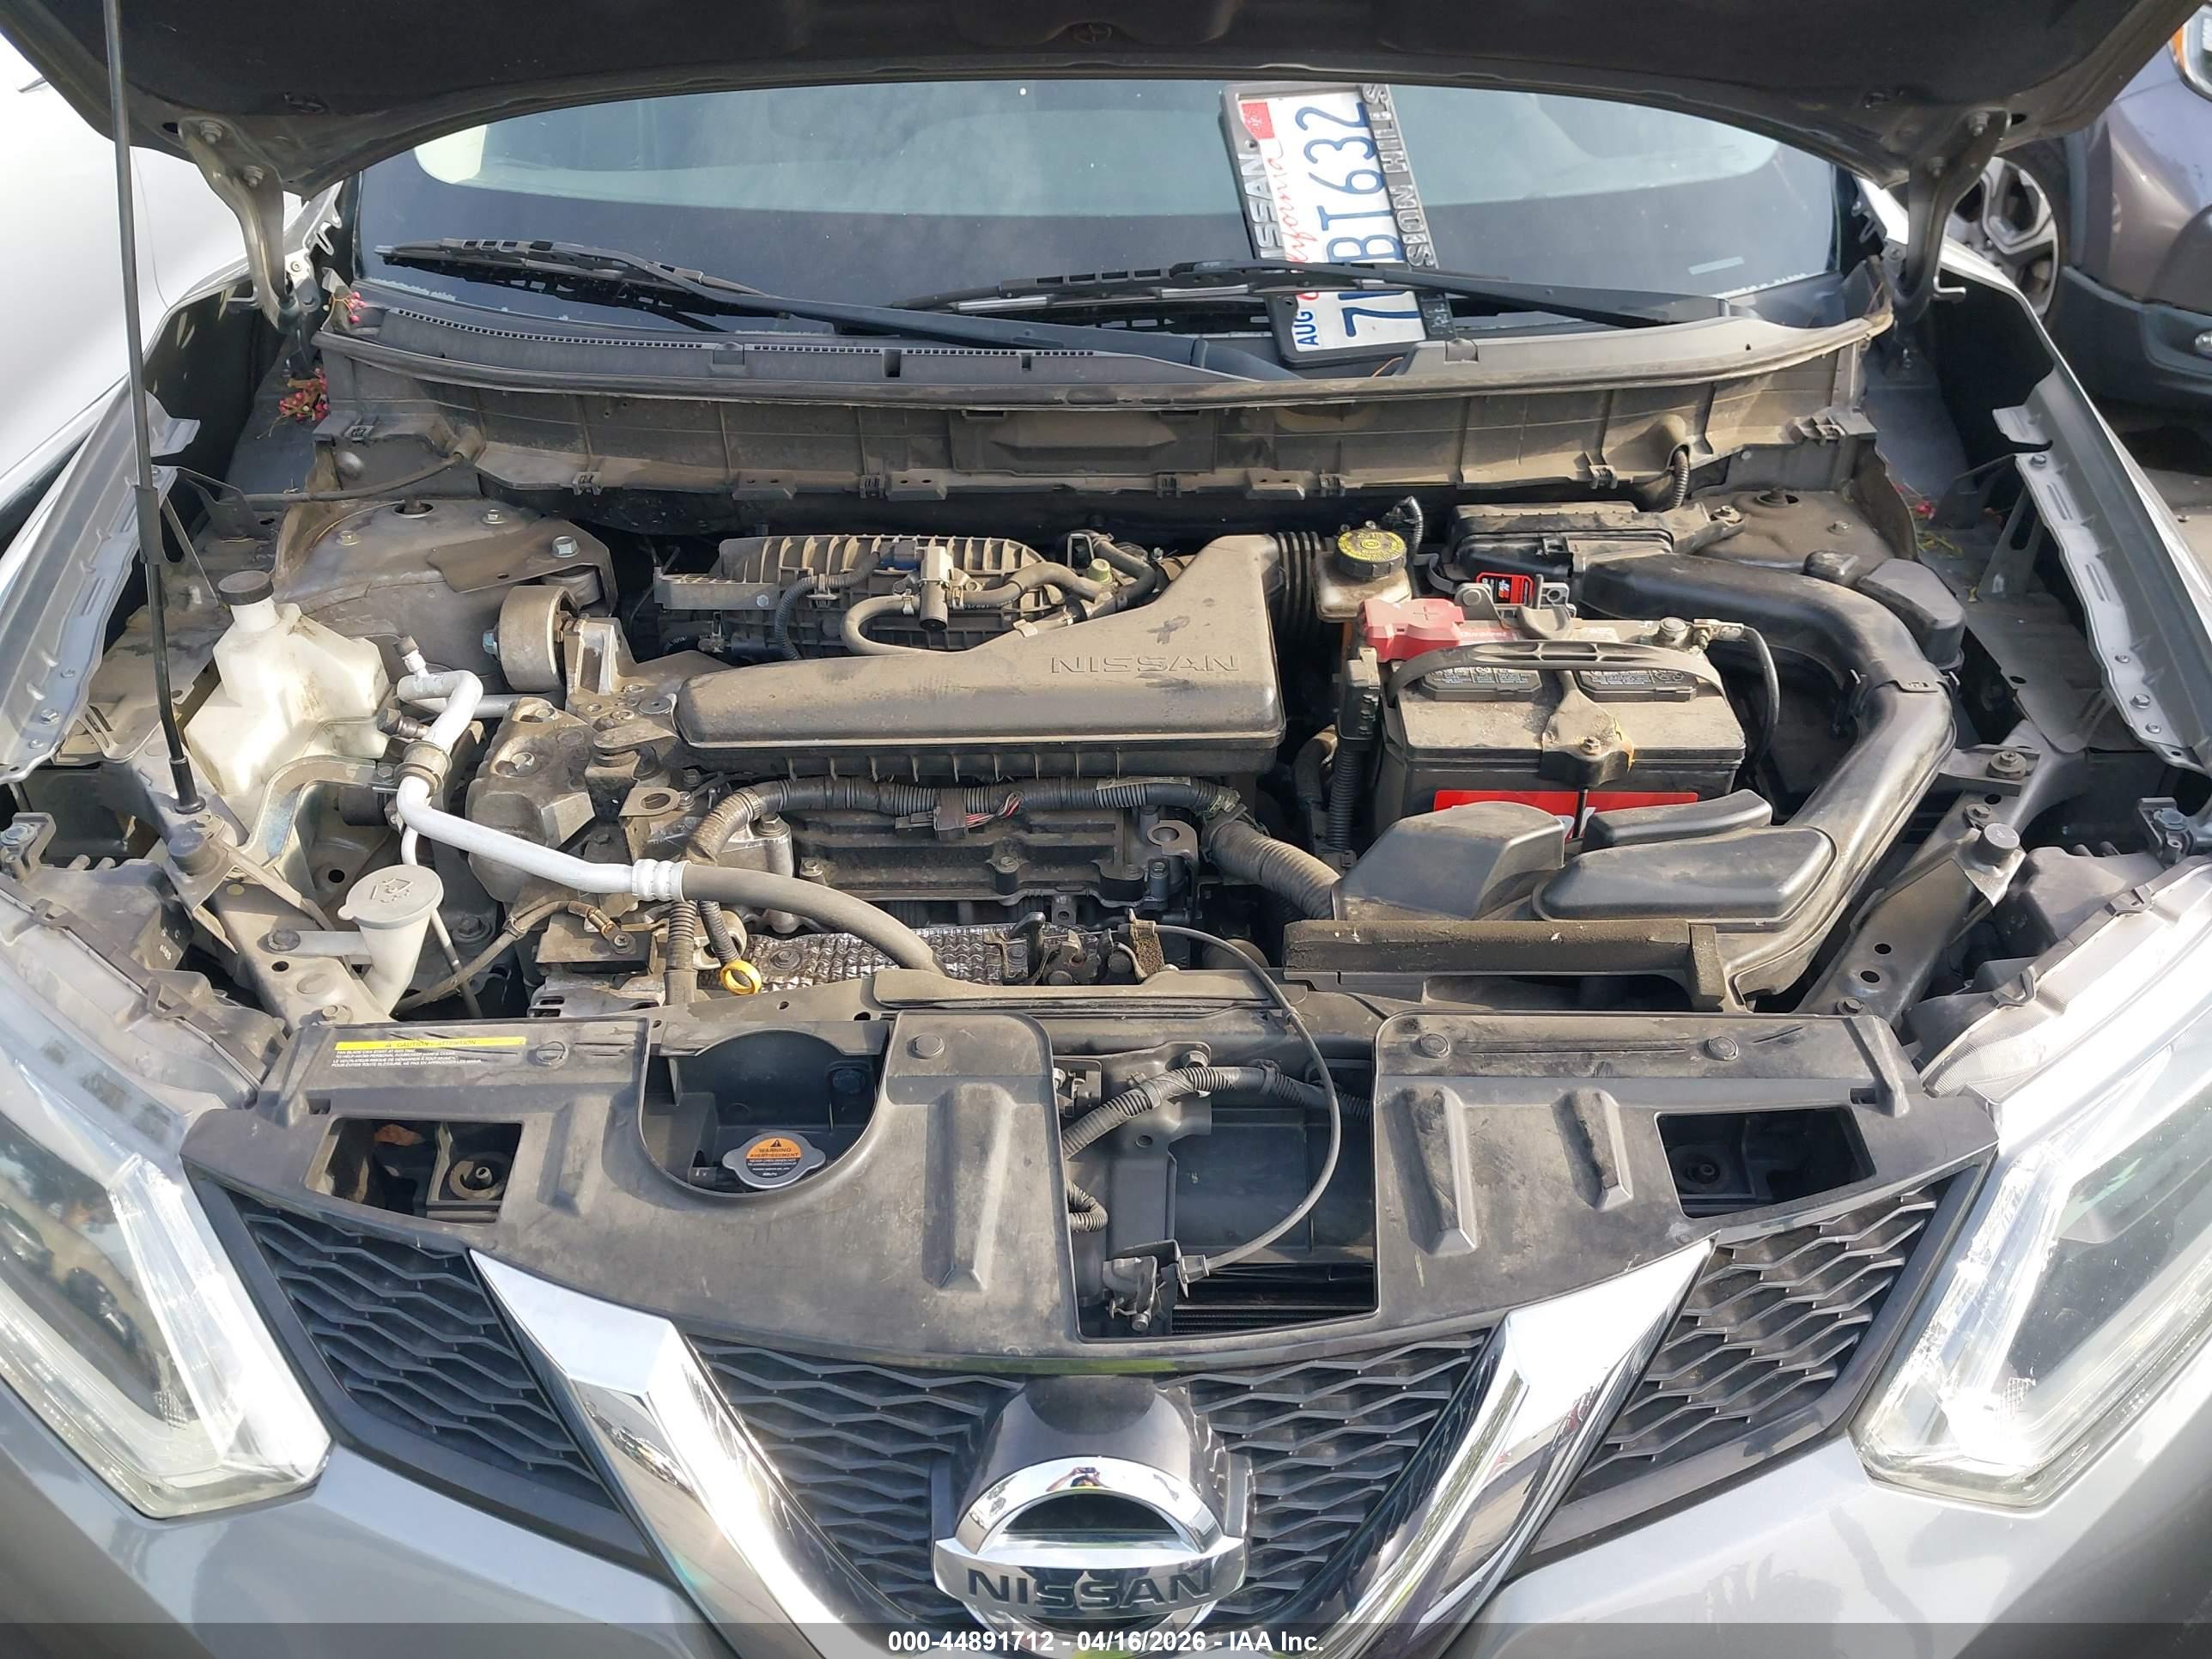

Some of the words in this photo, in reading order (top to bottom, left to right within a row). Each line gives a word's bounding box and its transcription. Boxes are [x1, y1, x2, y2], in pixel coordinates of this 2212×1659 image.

[1237, 153, 1288, 260] ISSAN
[1295, 101, 1421, 337] 7BT632
[1295, 310, 1320, 346] AUG
[1051, 654, 1239, 674] NISSAN
[968, 1568, 1214, 1609] NISSAN
